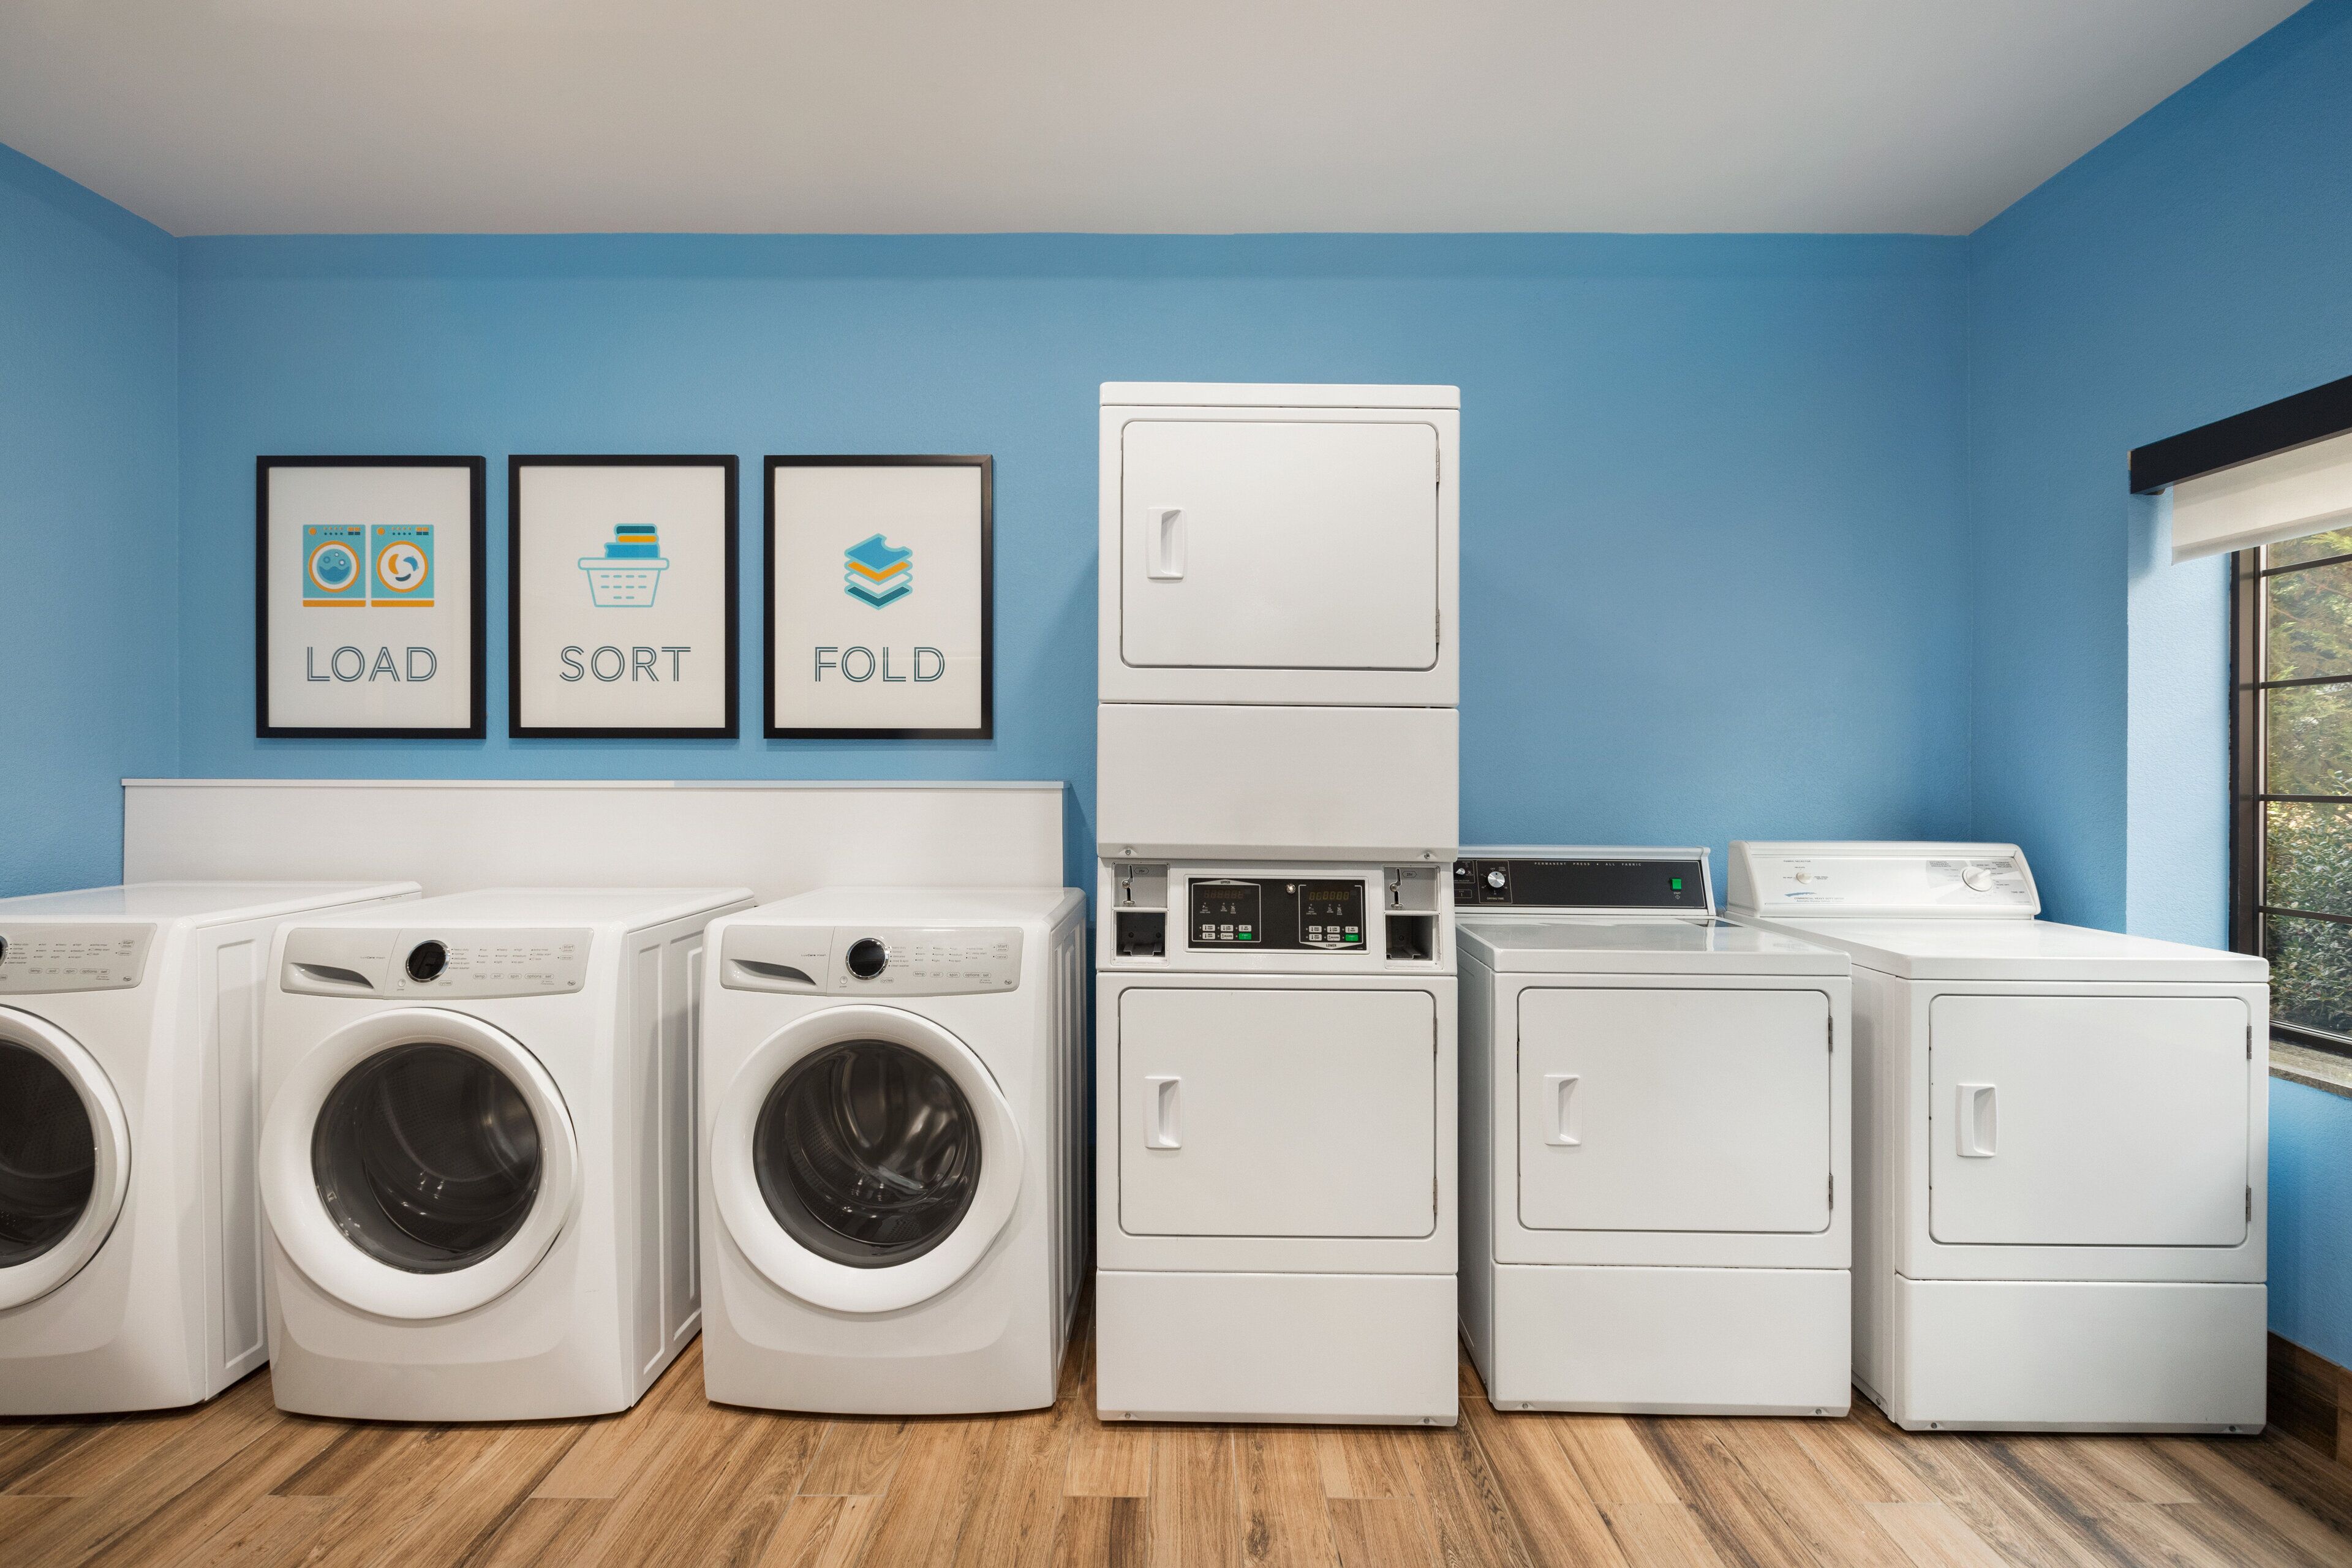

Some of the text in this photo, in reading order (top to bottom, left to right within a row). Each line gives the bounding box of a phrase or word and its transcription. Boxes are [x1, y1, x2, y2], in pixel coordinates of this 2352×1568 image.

[307, 646, 437, 682] LOAD
[560, 646, 691, 682] SORT
[815, 647, 944, 682] FOLD
